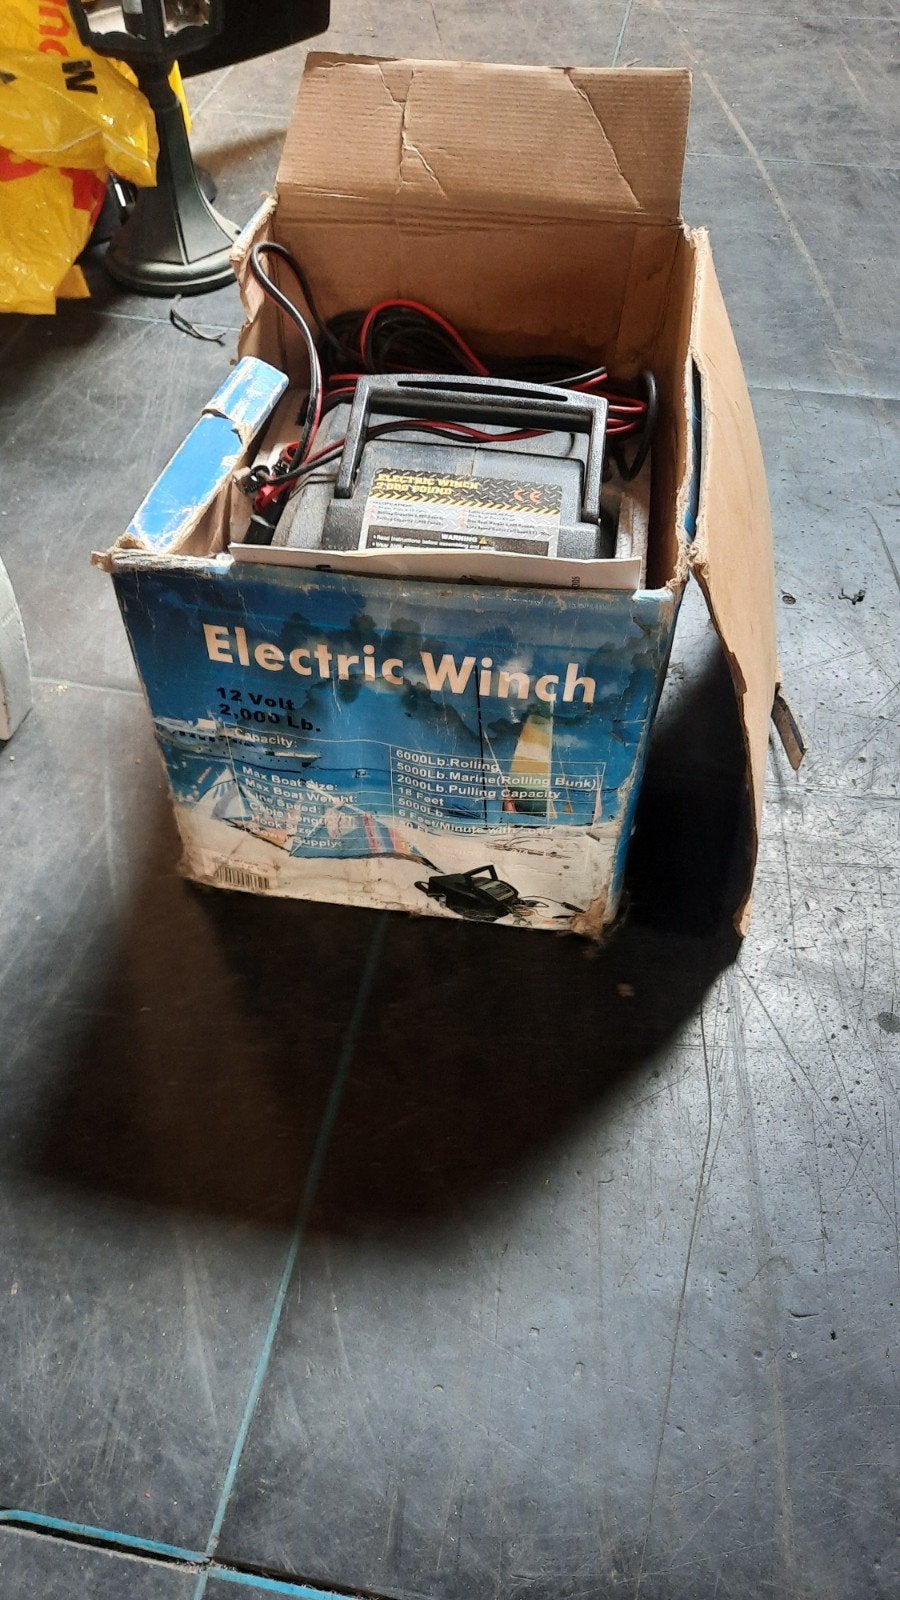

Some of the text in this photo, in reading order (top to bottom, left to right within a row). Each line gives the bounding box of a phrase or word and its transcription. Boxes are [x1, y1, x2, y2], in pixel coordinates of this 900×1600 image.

[376, 473, 480, 490] ELECTRIC WINCH
[441, 533, 478, 543] WARNING
[203, 623, 596, 703] Electric Winch
[217, 687, 295, 711] 12 Volt
[220, 703, 321, 732] 2,000 Lb.
[235, 728, 298, 748] Capacity:
[242, 766, 338, 792] Max Boat Size:
[555, 777, 596, 790] Bunk)
[245, 778, 270, 792] Max
[273, 786, 303, 800] Boat
[398, 787, 444, 806] 18 Feet
[501, 789, 561, 799] Capacity
[292, 836, 342, 848] Supply:
